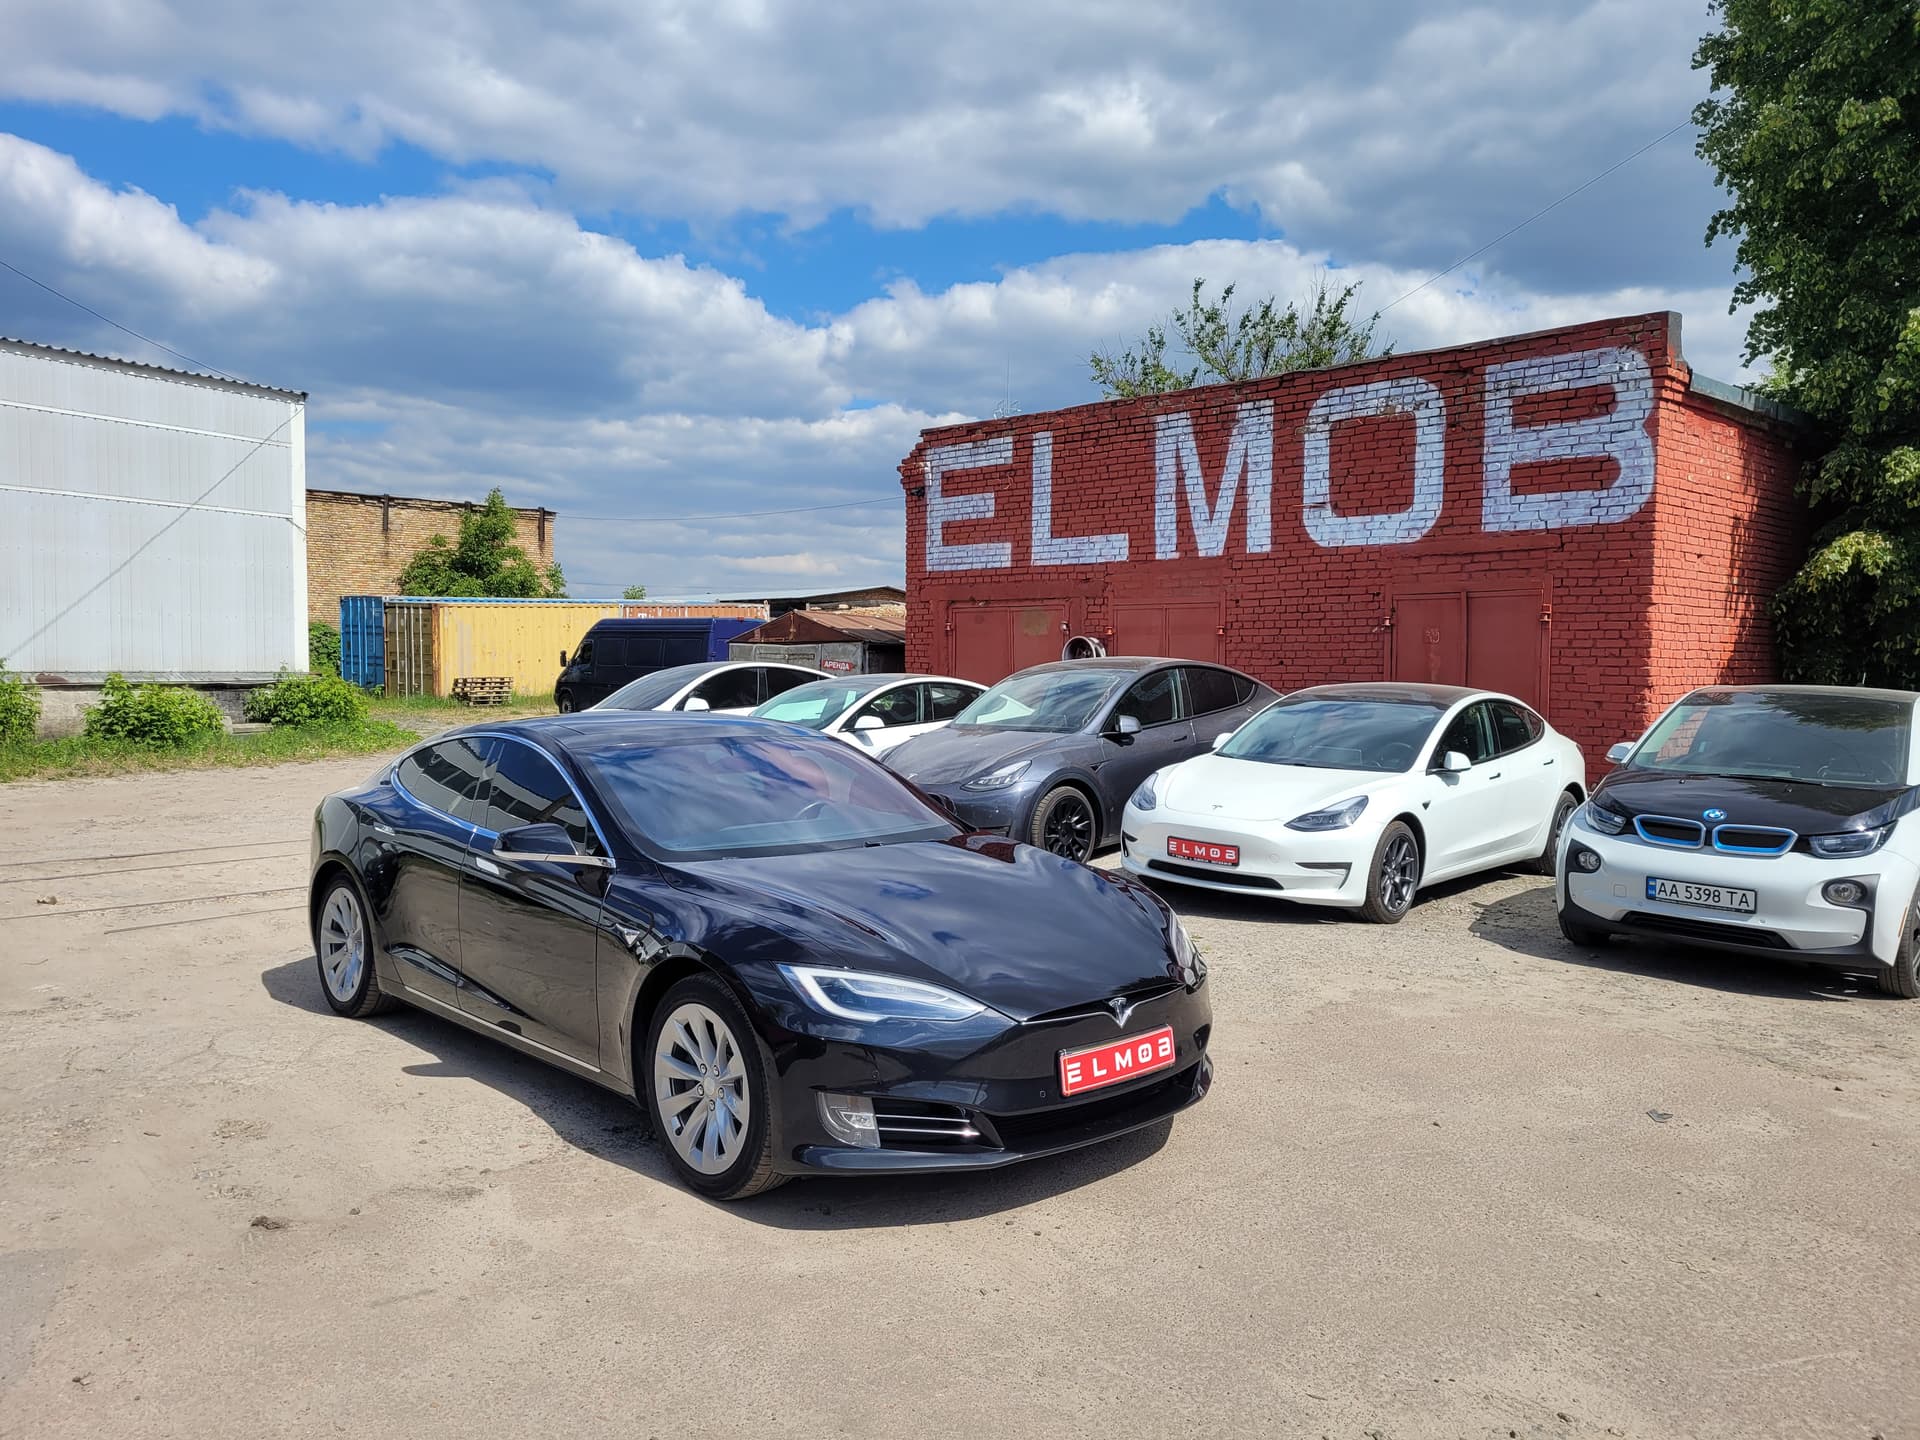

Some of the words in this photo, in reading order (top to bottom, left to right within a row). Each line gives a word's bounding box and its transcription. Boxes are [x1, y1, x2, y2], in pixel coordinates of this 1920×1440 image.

[924, 347, 1657, 573] ELMOB
[1657, 882, 1679, 898] AA
[1684, 886, 1721, 903] 5398
[1726, 891, 1750, 908] TA
